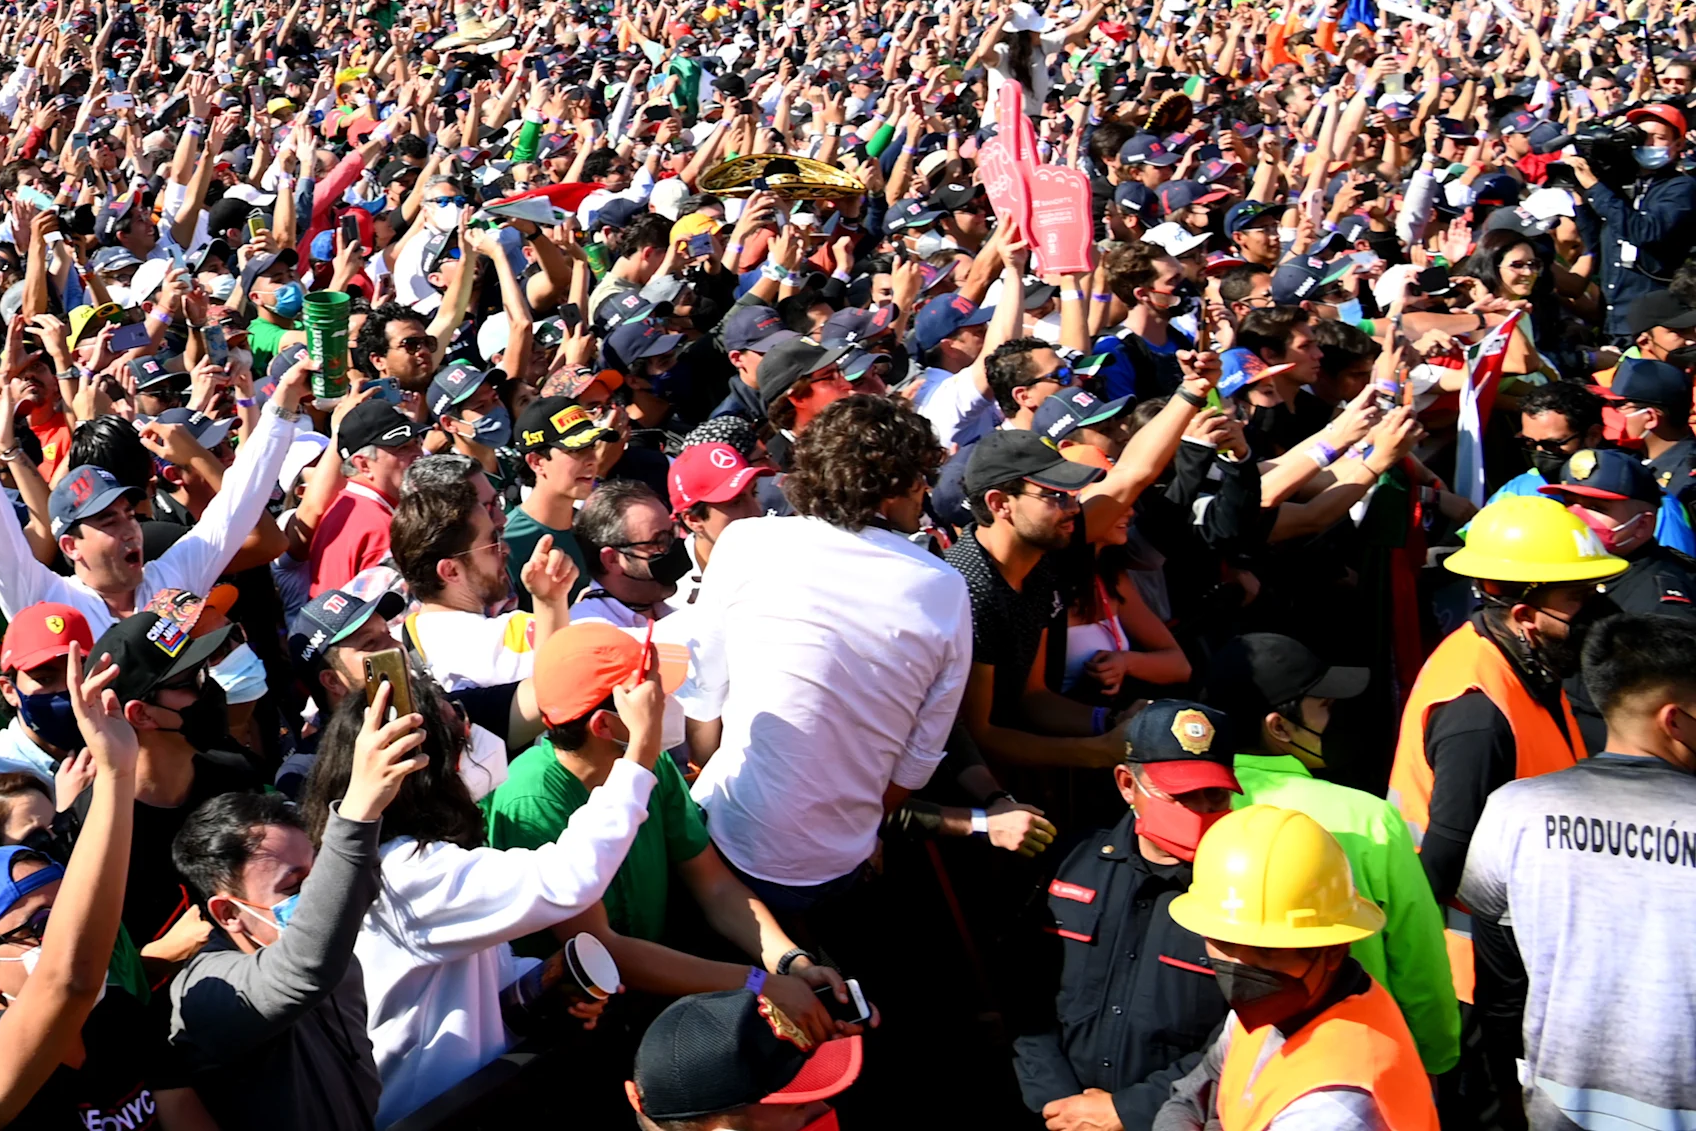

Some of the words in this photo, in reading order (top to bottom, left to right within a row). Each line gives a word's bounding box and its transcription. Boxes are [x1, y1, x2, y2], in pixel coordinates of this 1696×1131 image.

[522, 430, 545, 447] 1ST
[323, 594, 348, 614] 11
[1545, 814, 1696, 869] PRODUCCIÓN
